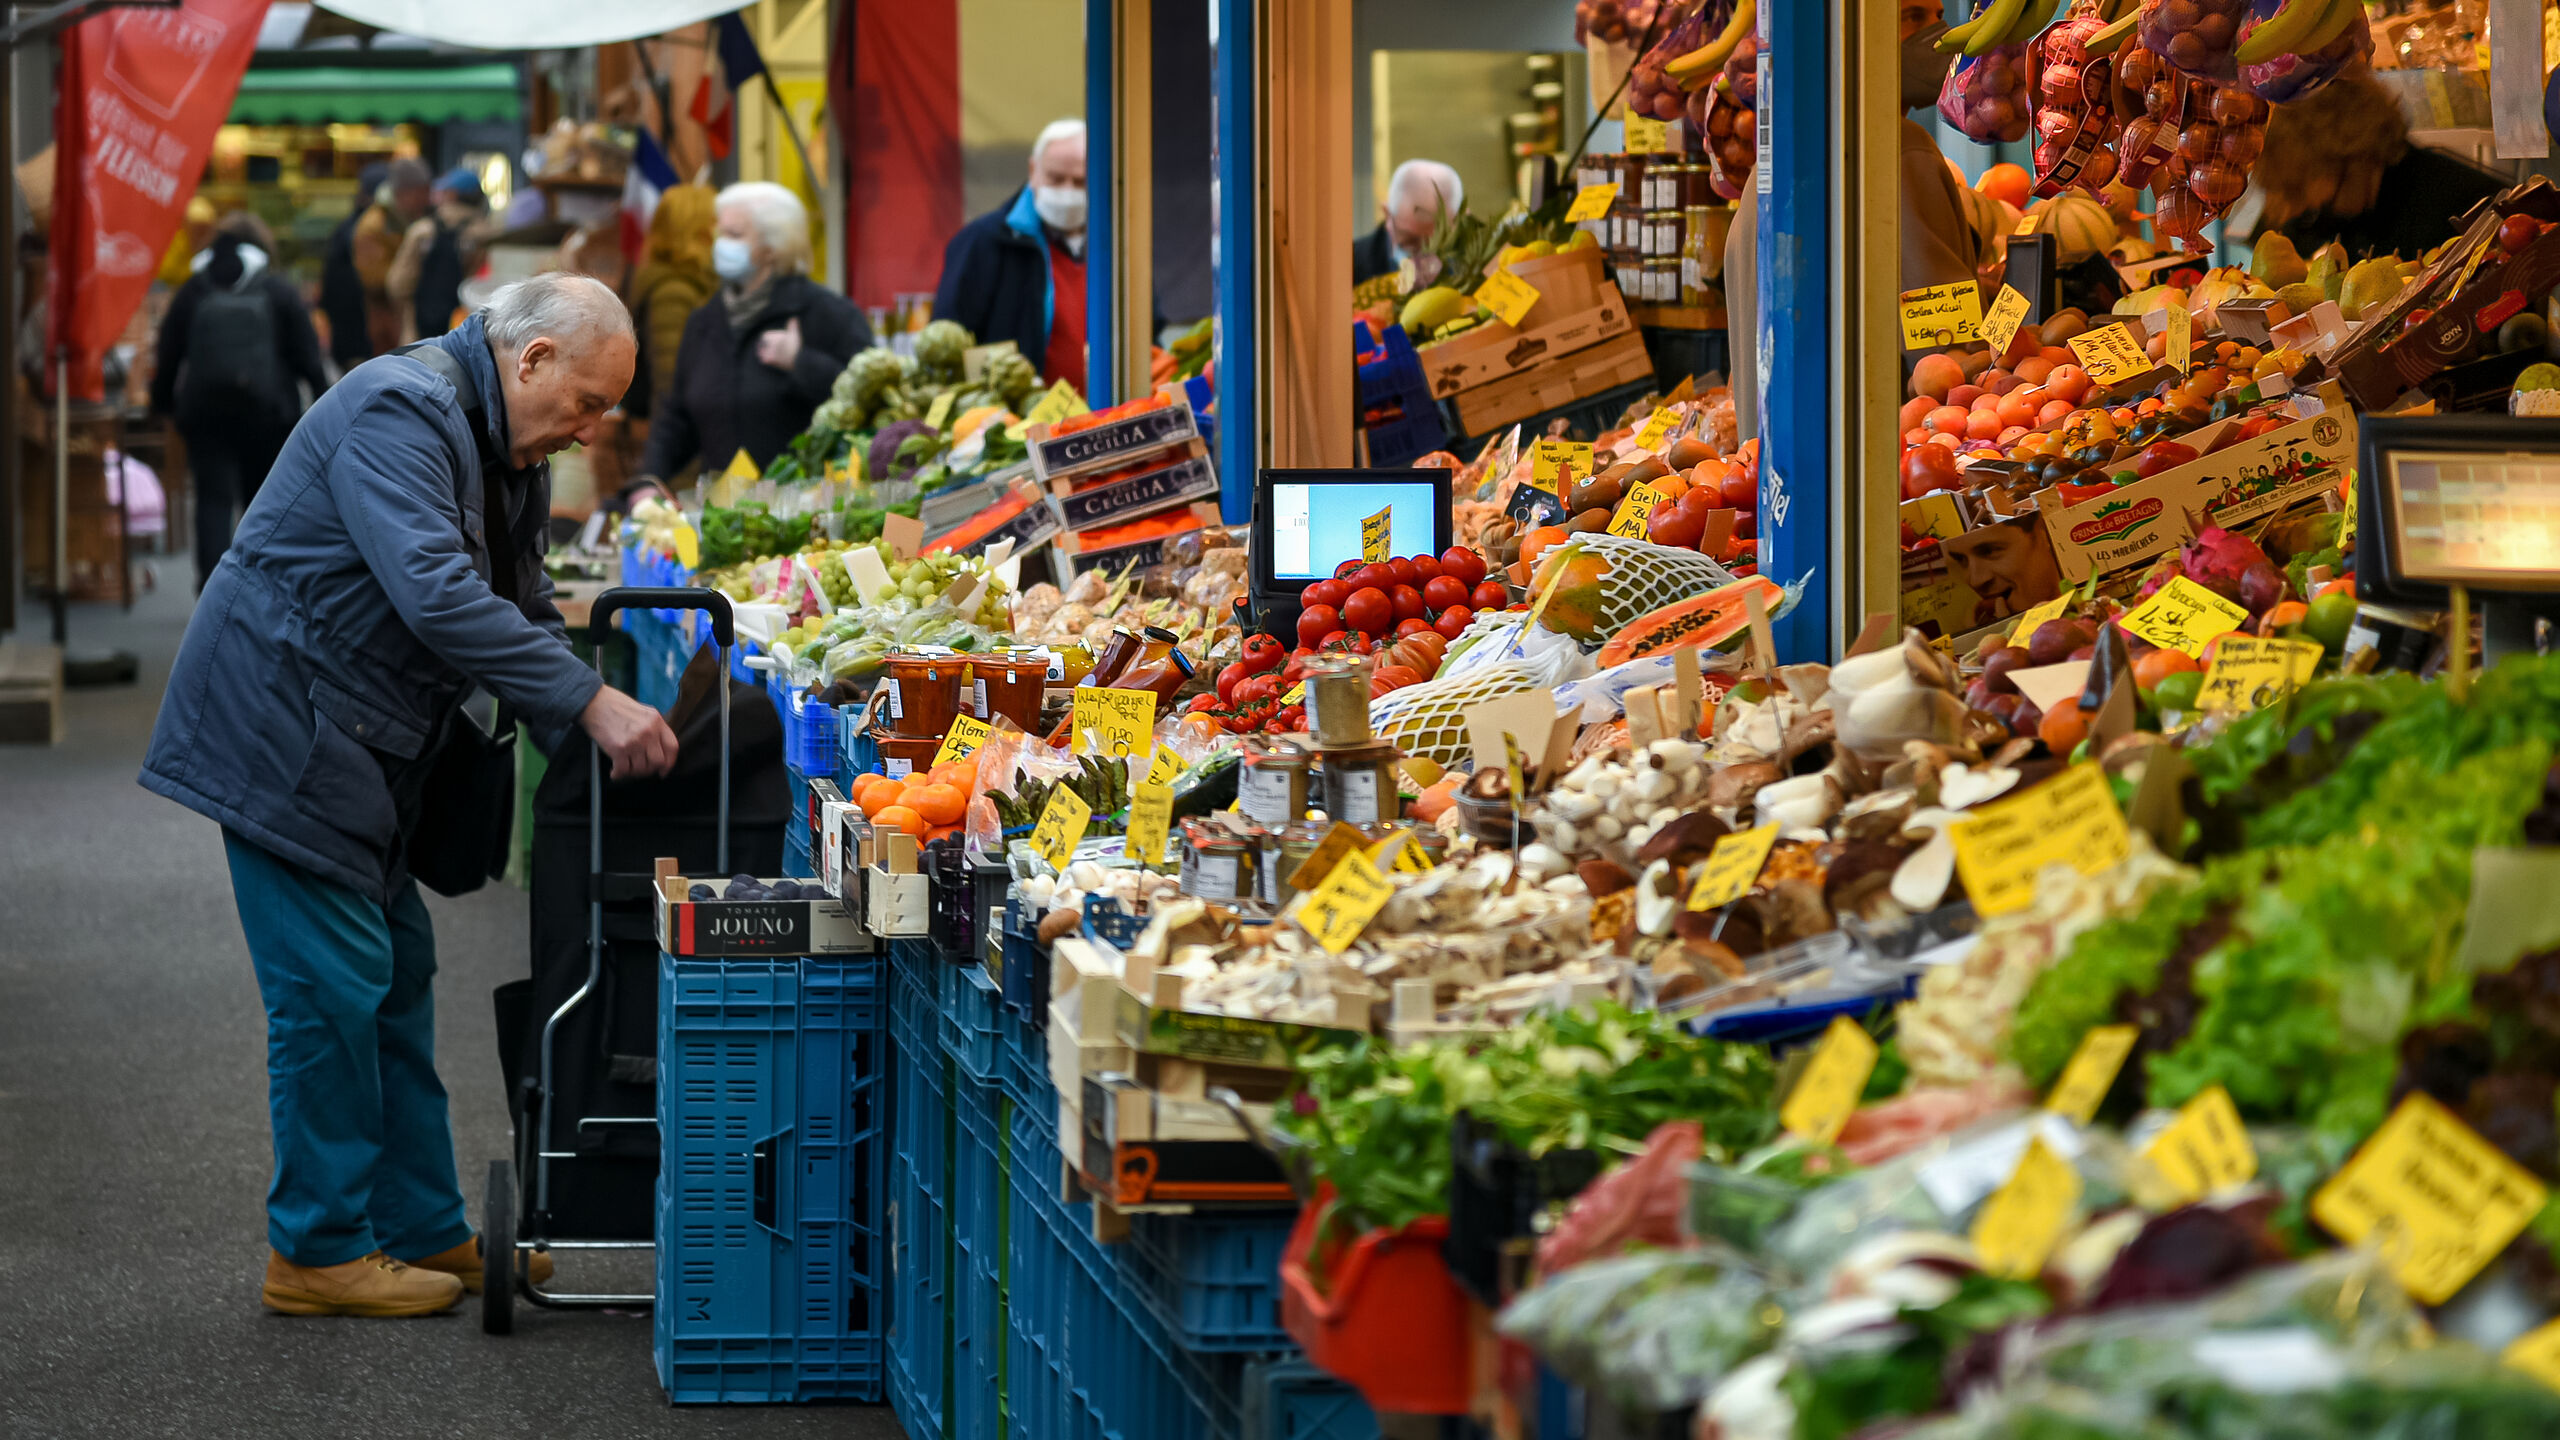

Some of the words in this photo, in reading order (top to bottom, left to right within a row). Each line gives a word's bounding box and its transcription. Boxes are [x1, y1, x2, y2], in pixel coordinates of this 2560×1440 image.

[1934, 300, 1962, 314] Kiwi
[2440, 324, 2463, 345] JOYN
[1065, 425, 1147, 460] CECILIA
[1084, 479, 1166, 515] CECILIA
[2270, 492, 2279, 501] de
[2072, 521, 2105, 542] PRINCE
[2105, 519, 2114, 529] de
[2114, 500, 2162, 527] BRETAGNE
[2096, 548, 2112, 561] LES
[727, 907, 776, 915] TOMATE
[709, 917, 795, 936] JOUNO
